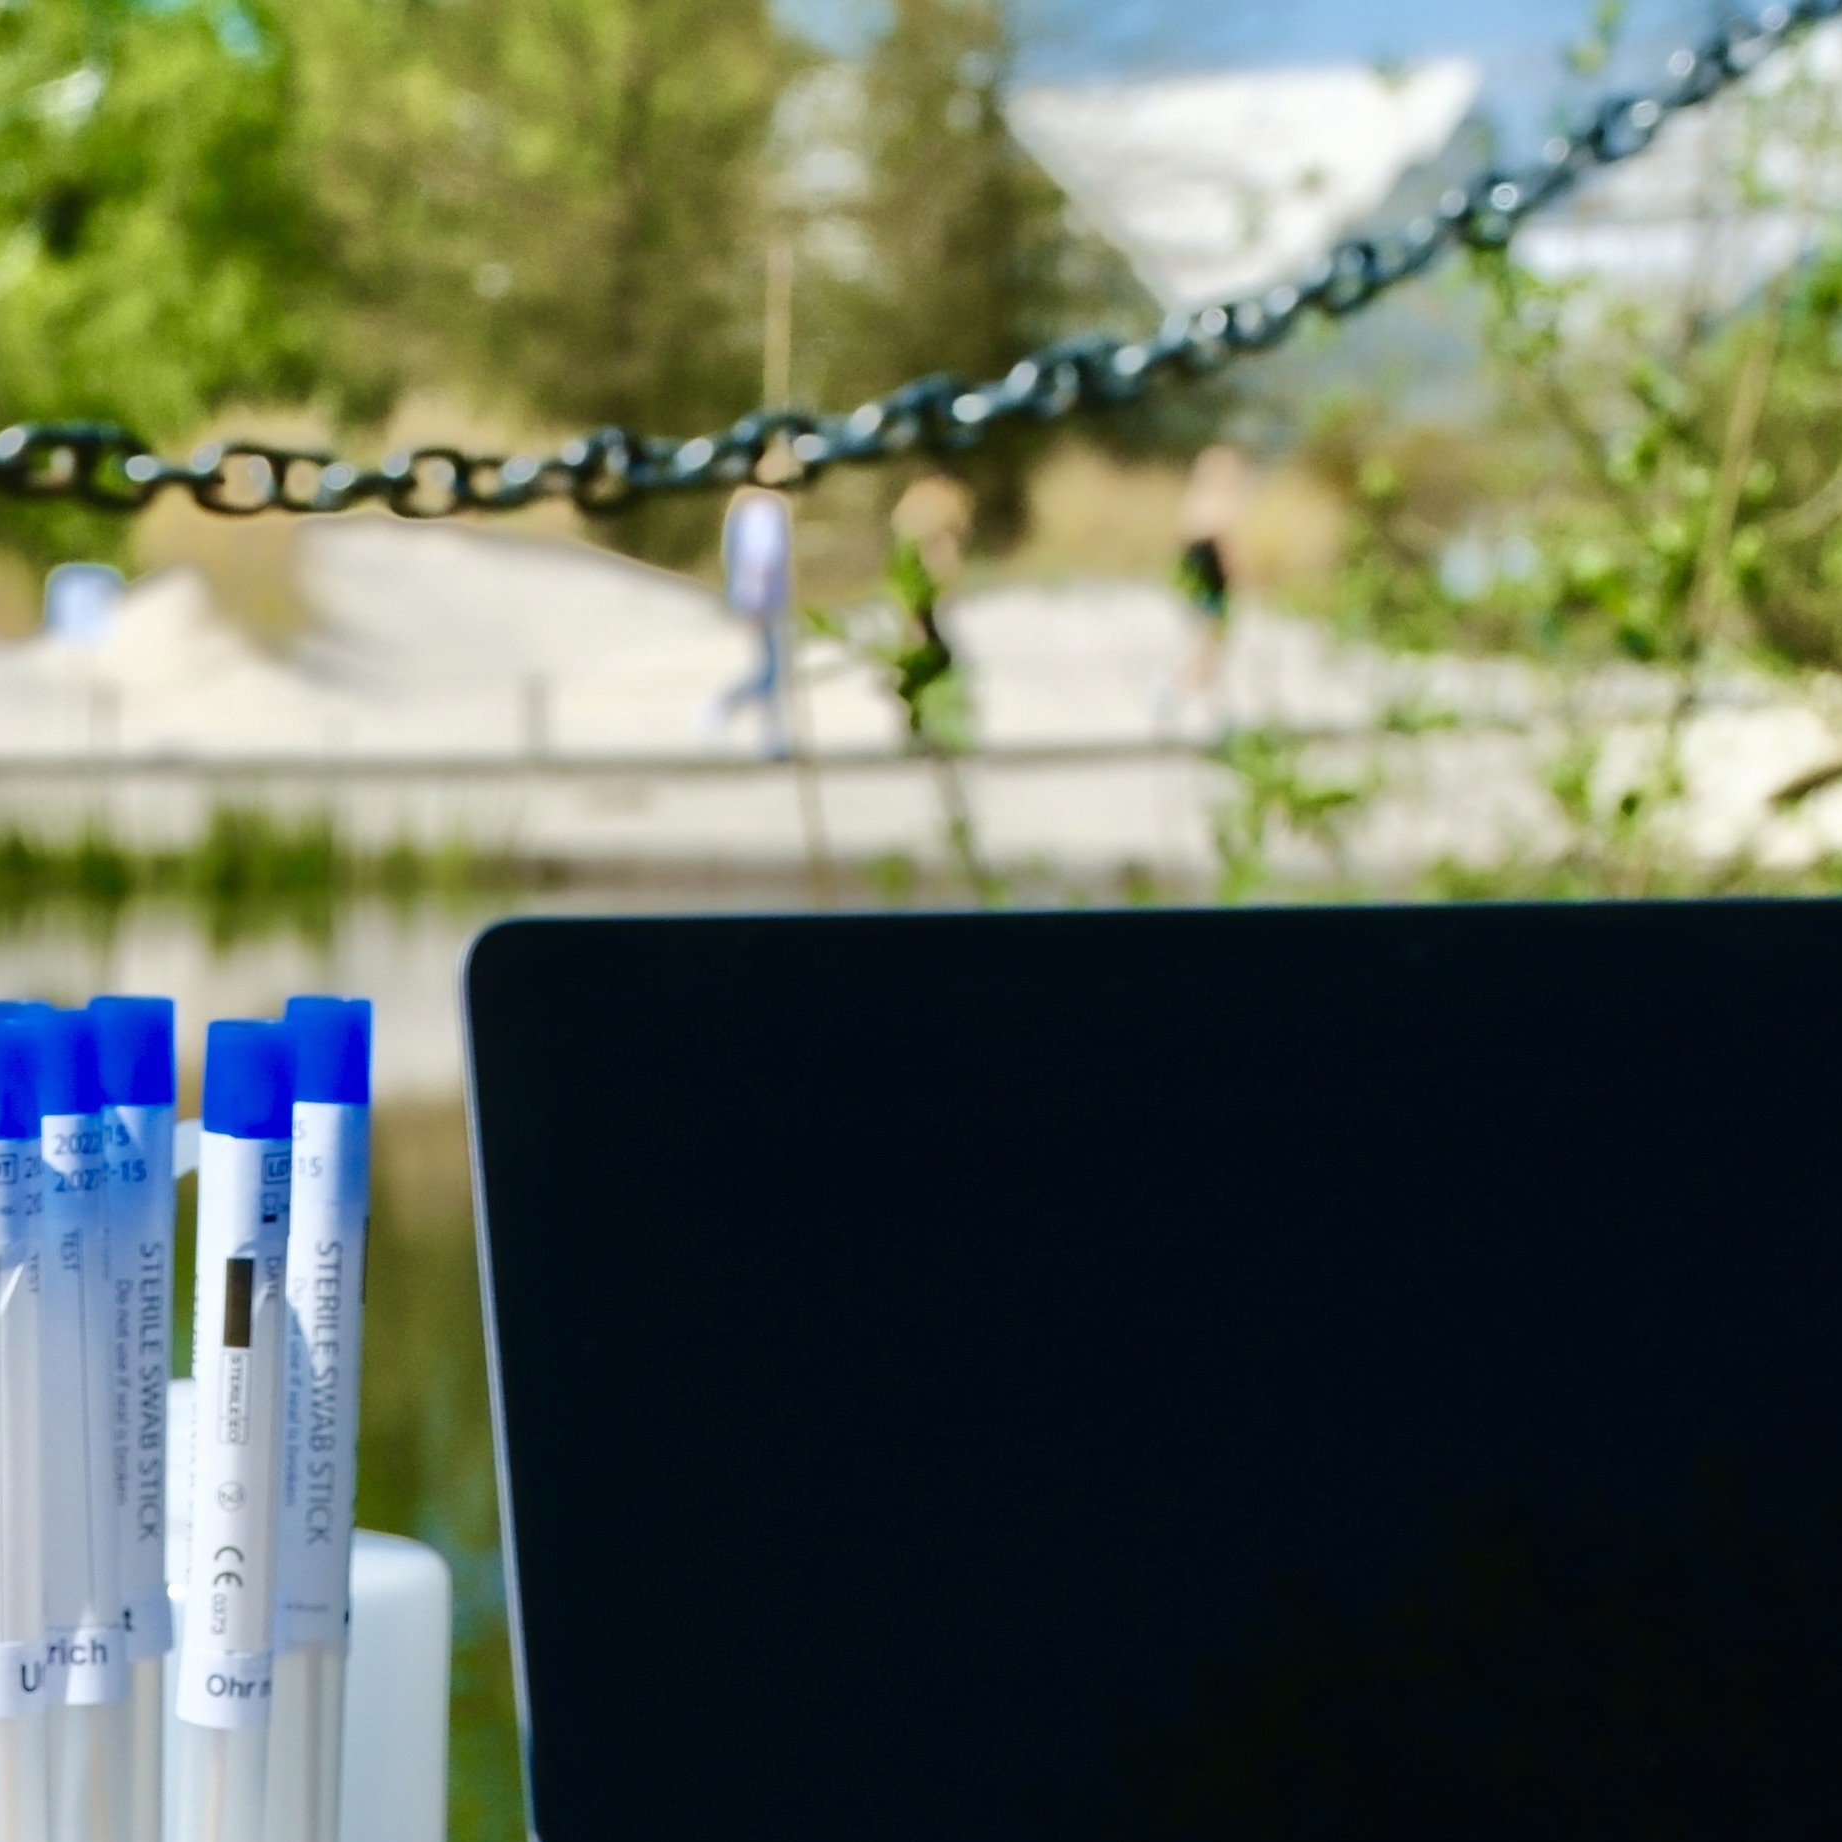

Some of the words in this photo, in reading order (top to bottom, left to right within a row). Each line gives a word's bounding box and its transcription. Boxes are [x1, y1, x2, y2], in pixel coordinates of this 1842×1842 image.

[61, 1230, 80, 1272] TEST
[115, 1279, 134, 1305] Do
[138, 1241, 164, 1356] STERILE
[313, 1240, 344, 1356] STERILE
[138, 1364, 164, 1450] SWAB
[308, 1365, 341, 1452] SWAB
[136, 1457, 163, 1543] STICK
[306, 1461, 336, 1546] STICK
[206, 1673, 255, 1697] Ohr
